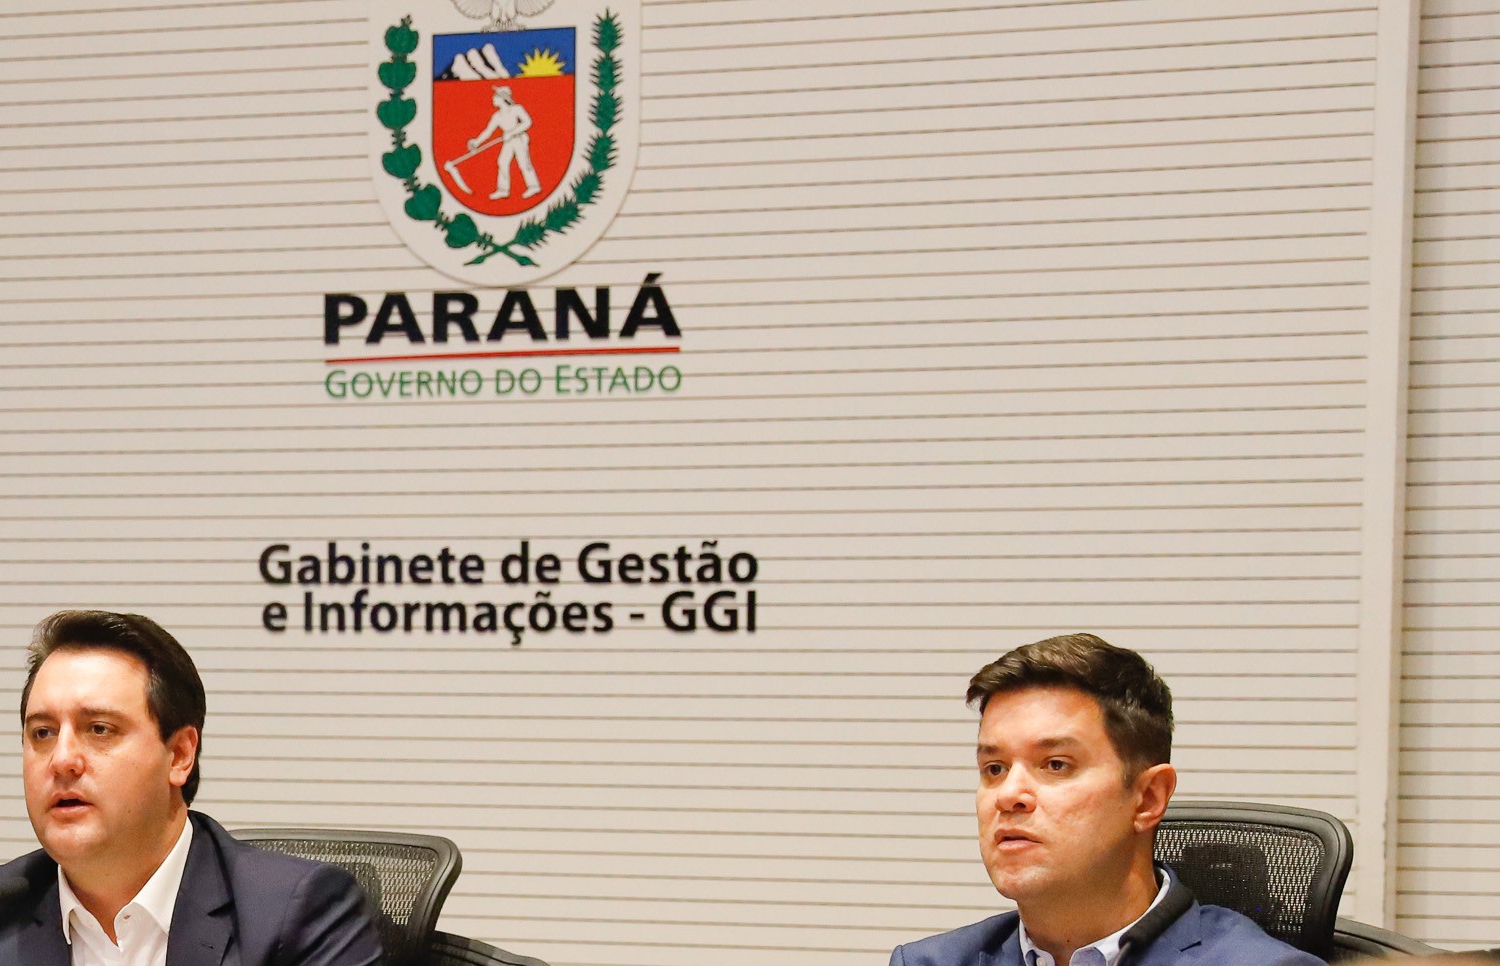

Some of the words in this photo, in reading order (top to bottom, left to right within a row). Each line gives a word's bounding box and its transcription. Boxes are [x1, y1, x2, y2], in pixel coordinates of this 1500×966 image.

[323, 273, 682, 345] PARANÁ
[325, 369, 482, 399] GOVERNO
[494, 368, 542, 395] DO
[555, 365, 682, 395] ESTADO
[258, 542, 485, 586] Gabinete
[501, 540, 562, 585] de
[577, 541, 759, 584] Gestão
[262, 602, 288, 631] e
[304, 590, 614, 645] Informações
[662, 592, 757, 633] GGI
